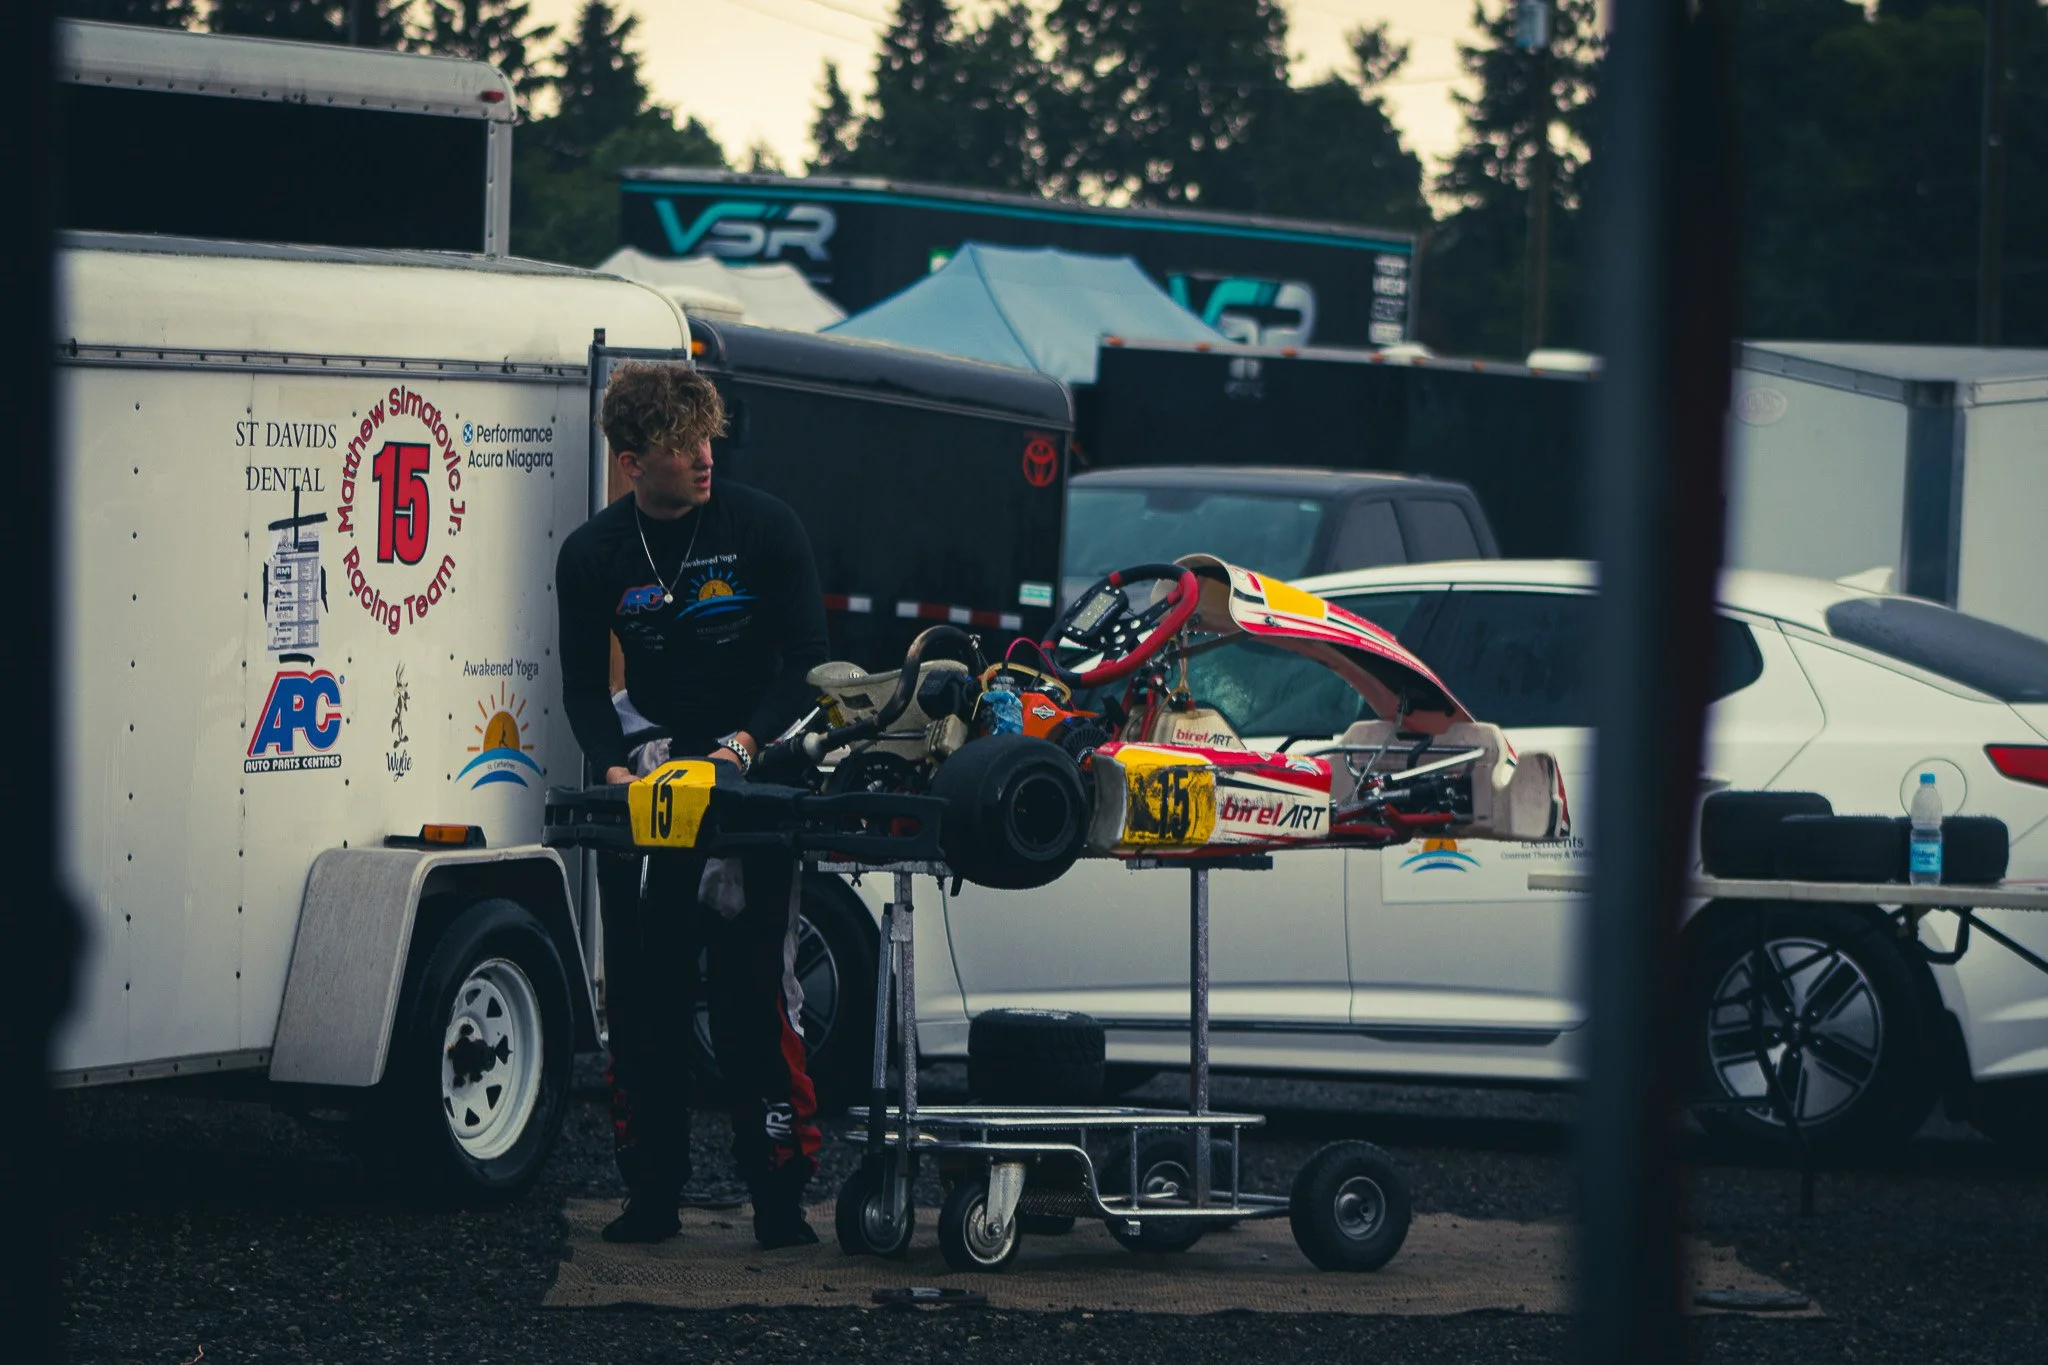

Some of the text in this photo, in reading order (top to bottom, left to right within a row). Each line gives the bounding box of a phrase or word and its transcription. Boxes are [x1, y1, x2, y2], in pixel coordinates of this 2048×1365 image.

[653, 198, 837, 261] VSR
[235, 421, 337, 449] ST DAVIDS
[476, 423, 553, 443] Performance
[338, 399, 385, 534] Matthew
[389, 385, 462, 492] Simatovic
[467, 448, 553, 473] Acura Niagara
[246, 466, 325, 492] DENTAL
[372, 440, 431, 566] 15
[343, 545, 402, 635] Racing
[403, 553, 456, 625] Team
[463, 657, 539, 681] Awakened Yoga
[246, 669, 342, 758] APC
[1175, 728, 1233, 747] birelART
[245, 755, 340, 773] AUTO PARTS CENTRES
[650, 769, 688, 839] 15
[1157, 768, 1190, 840] 15
[1220, 796, 1328, 831] birelART
[1533, 851, 1562, 861] Therapy
